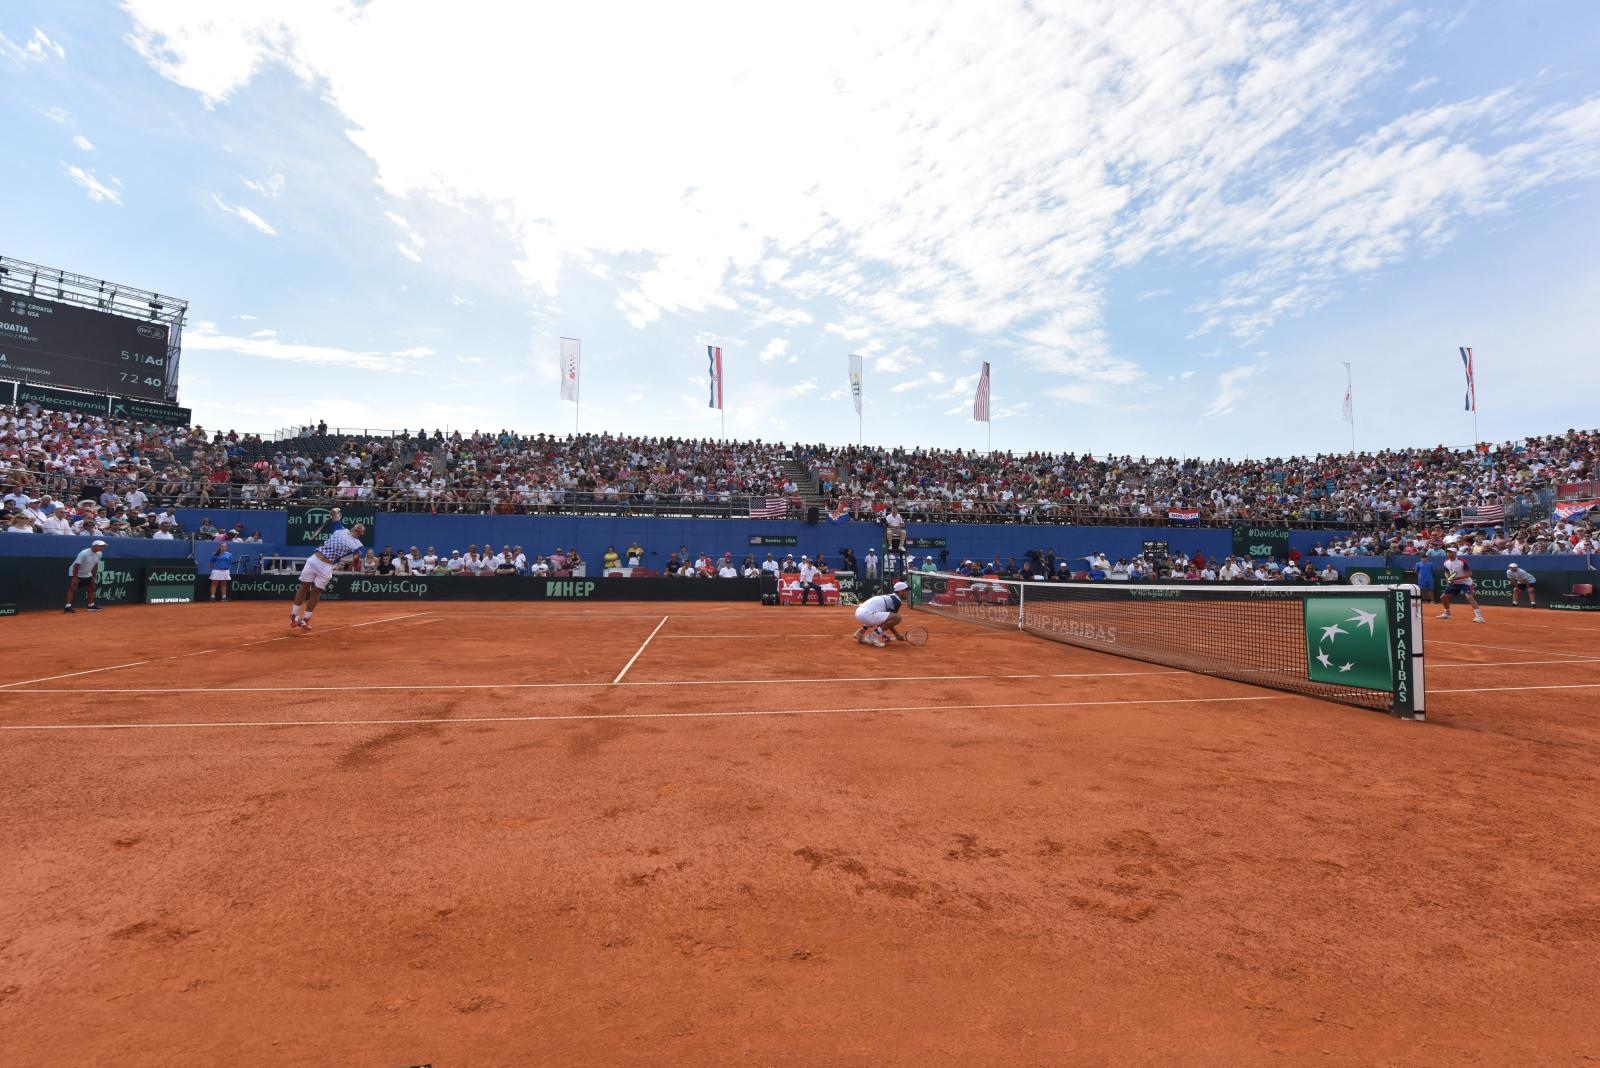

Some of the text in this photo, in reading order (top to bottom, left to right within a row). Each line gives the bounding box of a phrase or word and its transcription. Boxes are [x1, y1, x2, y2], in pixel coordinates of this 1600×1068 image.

[27, 310, 39, 318] USA
[28, 303, 53, 314] CROATIA
[121, 351, 130, 360] 5
[145, 355, 164, 367] Ad
[16, 366, 51, 376] HARRISON
[119, 372, 162, 388] 7 2 40
[20, 392, 107, 411] #adeccotennis
[287, 515, 302, 525] an
[342, 515, 375, 525] event
[1248, 528, 1289, 540] #DavisCup
[149, 572, 196, 582] Adecco
[350, 580, 428, 595] #DavisCup
[562, 581, 595, 597] HEP
[1481, 579, 1512, 589] CUP
[1052, 617, 1117, 643] PARIBAS
[1395, 591, 1408, 703] BNP PARIBAS
